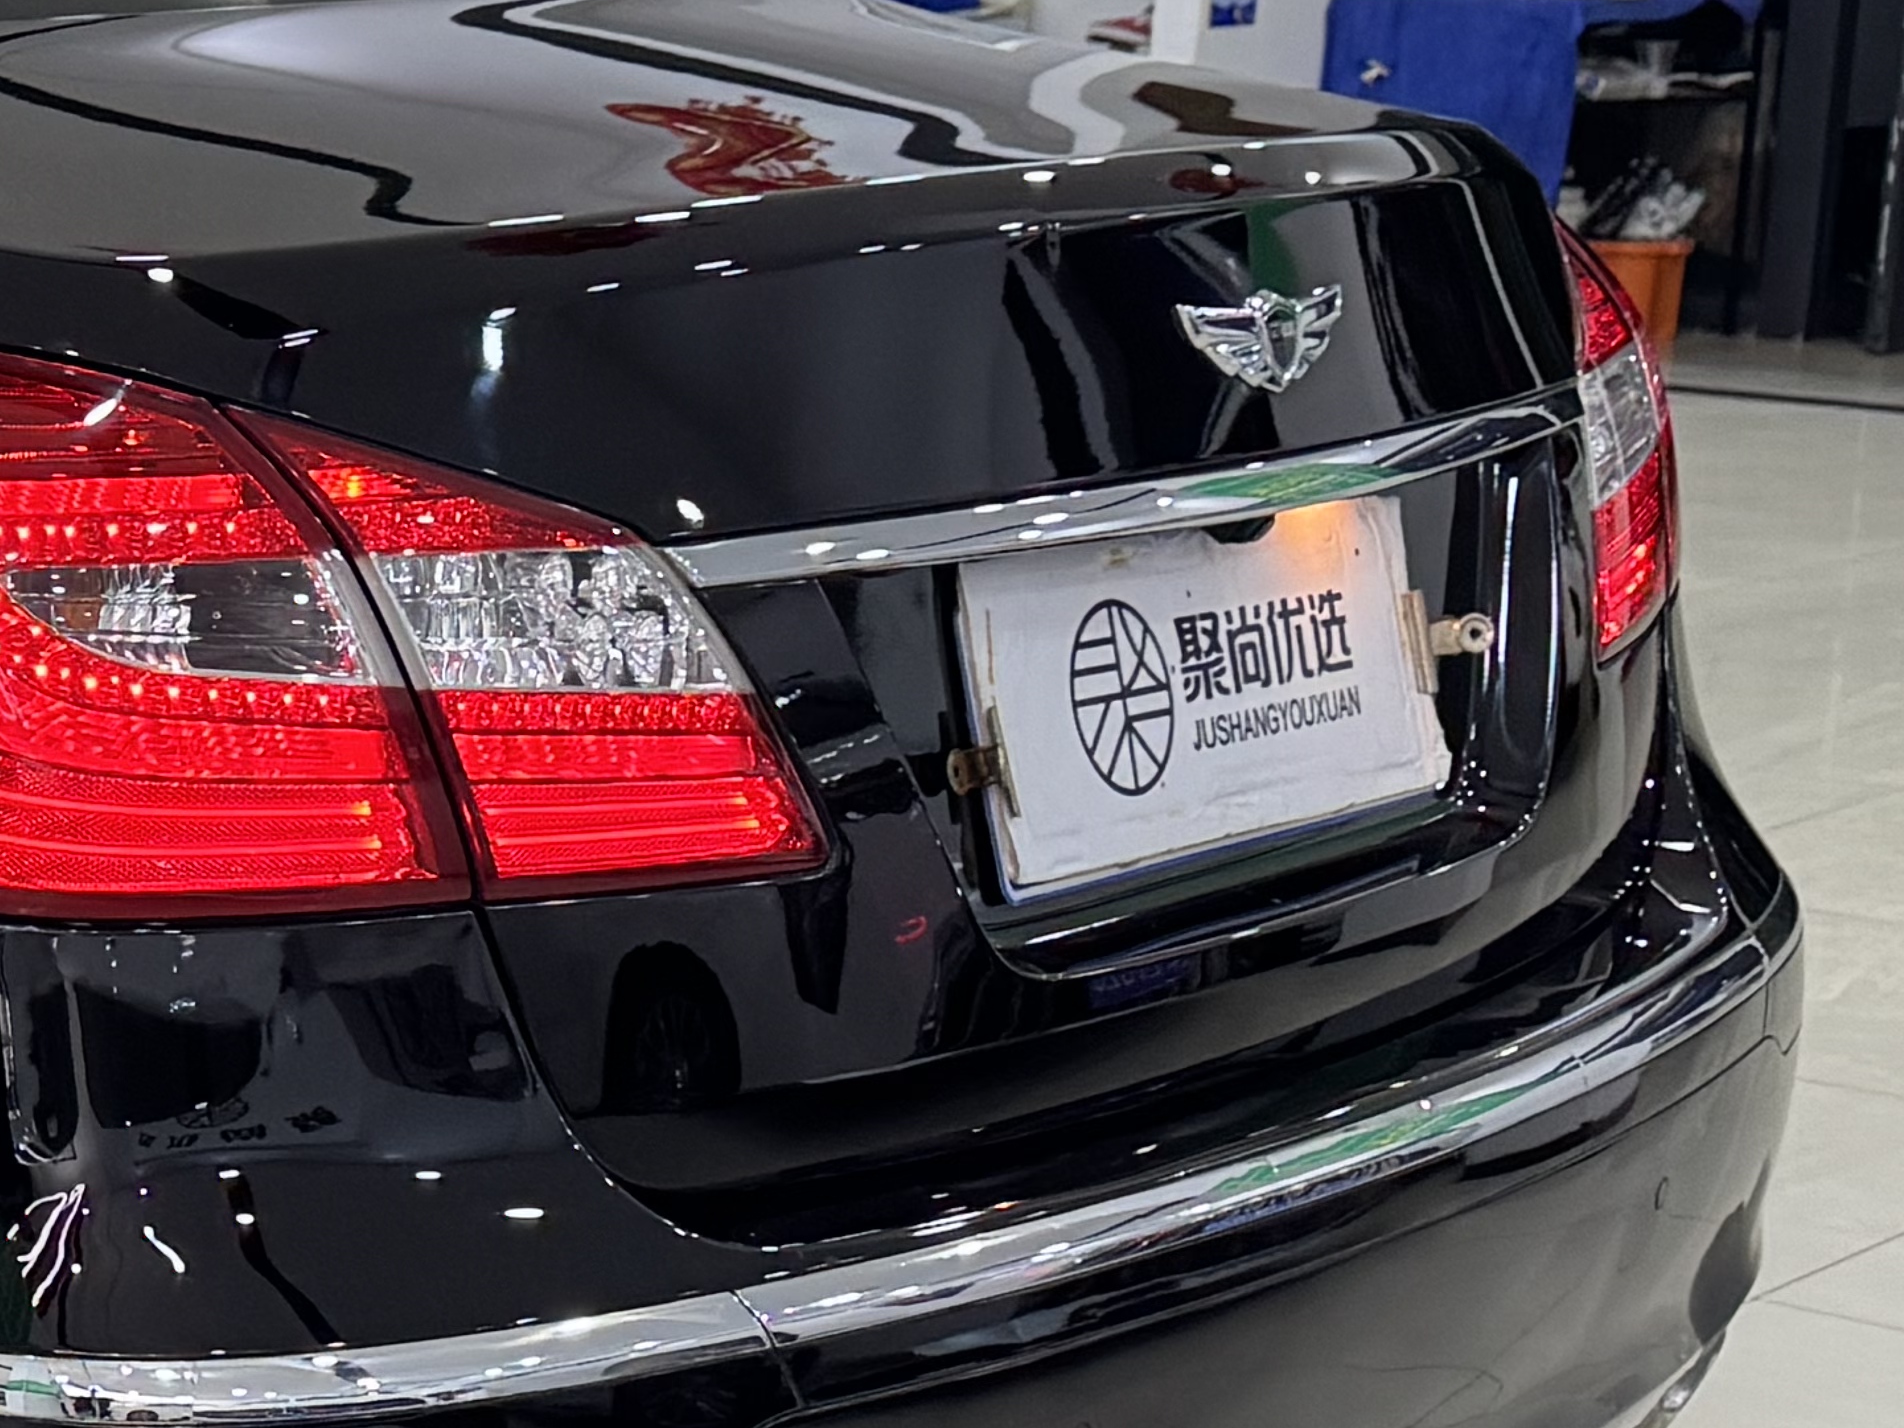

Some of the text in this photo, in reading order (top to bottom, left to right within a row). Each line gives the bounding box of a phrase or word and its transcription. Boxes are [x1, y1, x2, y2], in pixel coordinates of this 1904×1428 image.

[1173, 589, 1353, 703] 聚尚优选
[1193, 685, 1361, 751] JUSHANGYOUXUAN
